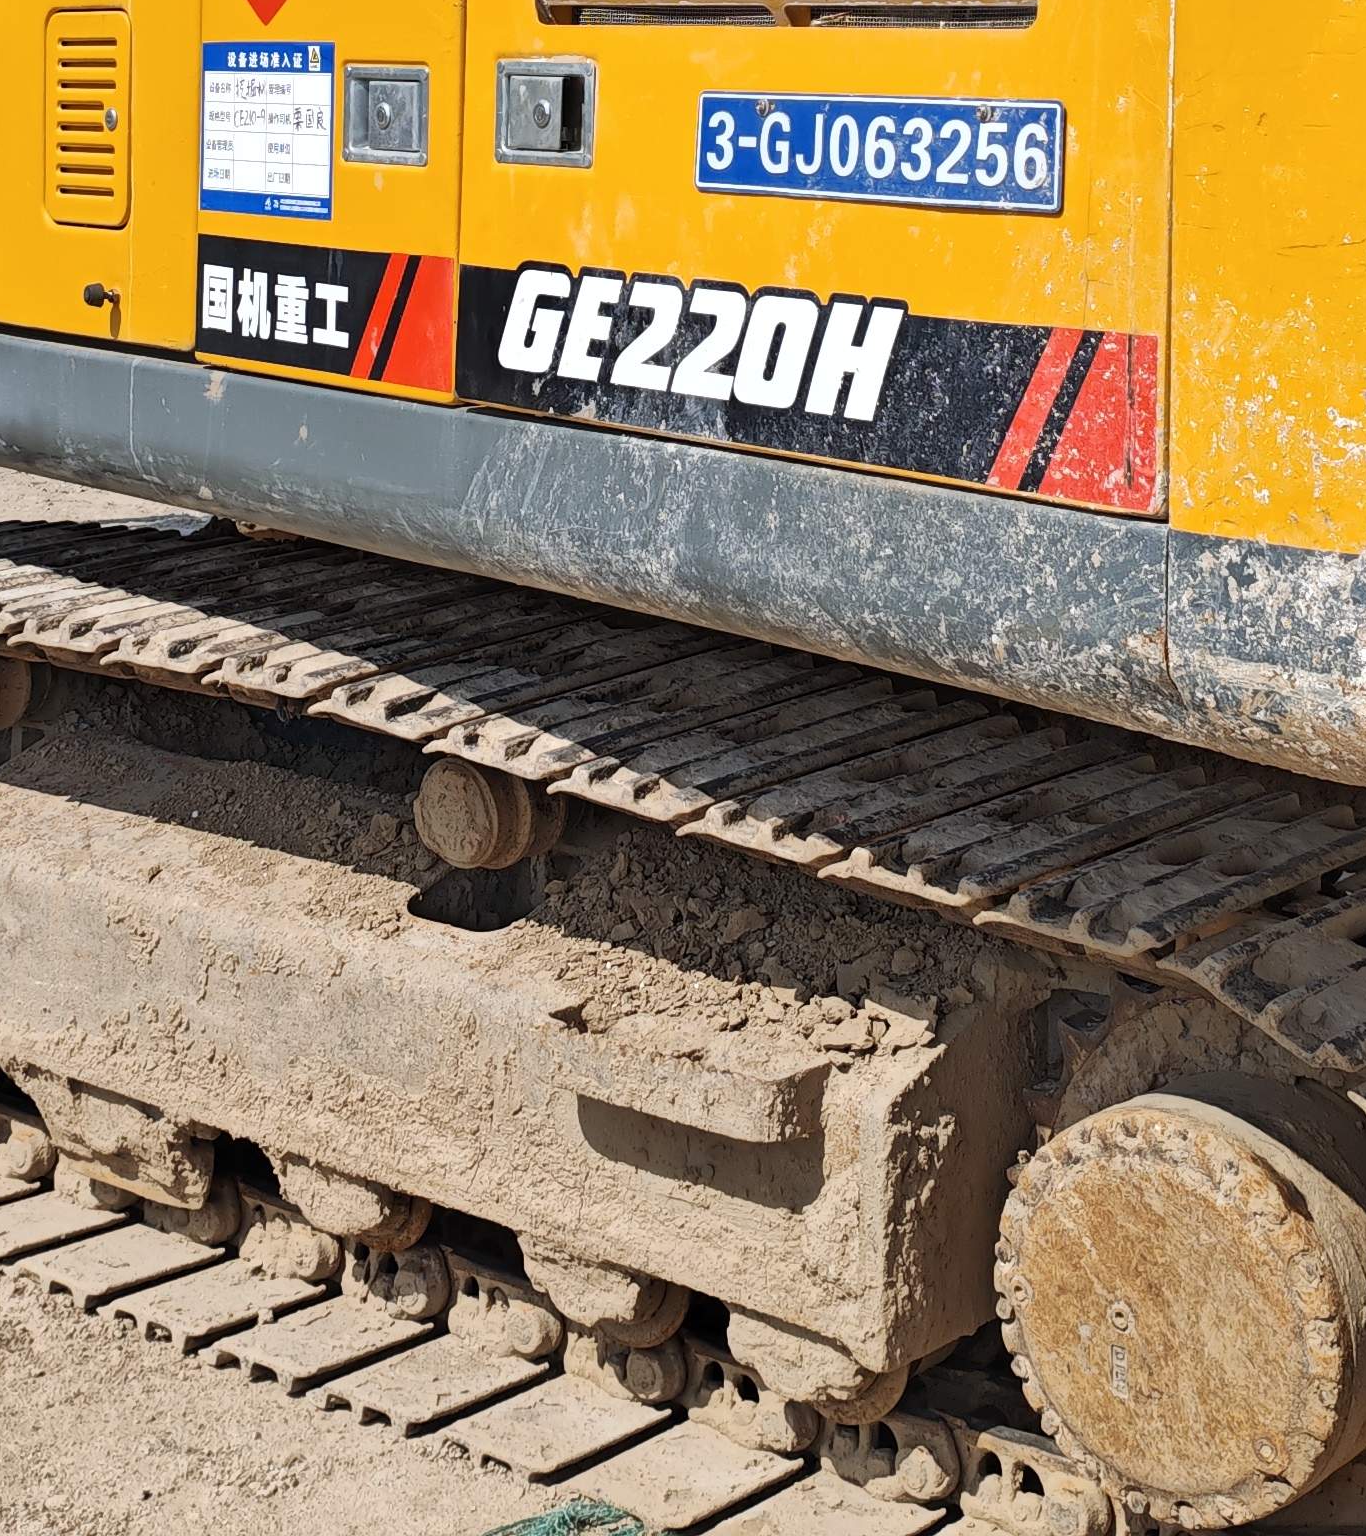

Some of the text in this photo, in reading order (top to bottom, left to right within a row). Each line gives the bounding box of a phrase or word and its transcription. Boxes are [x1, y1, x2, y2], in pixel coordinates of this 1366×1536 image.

[227, 51, 303, 68] 设备进场准入证
[706, 110, 1050, 190] 3-GJ063256
[202, 264, 349, 348] 国机重工
[497, 269, 905, 422] GE220H
